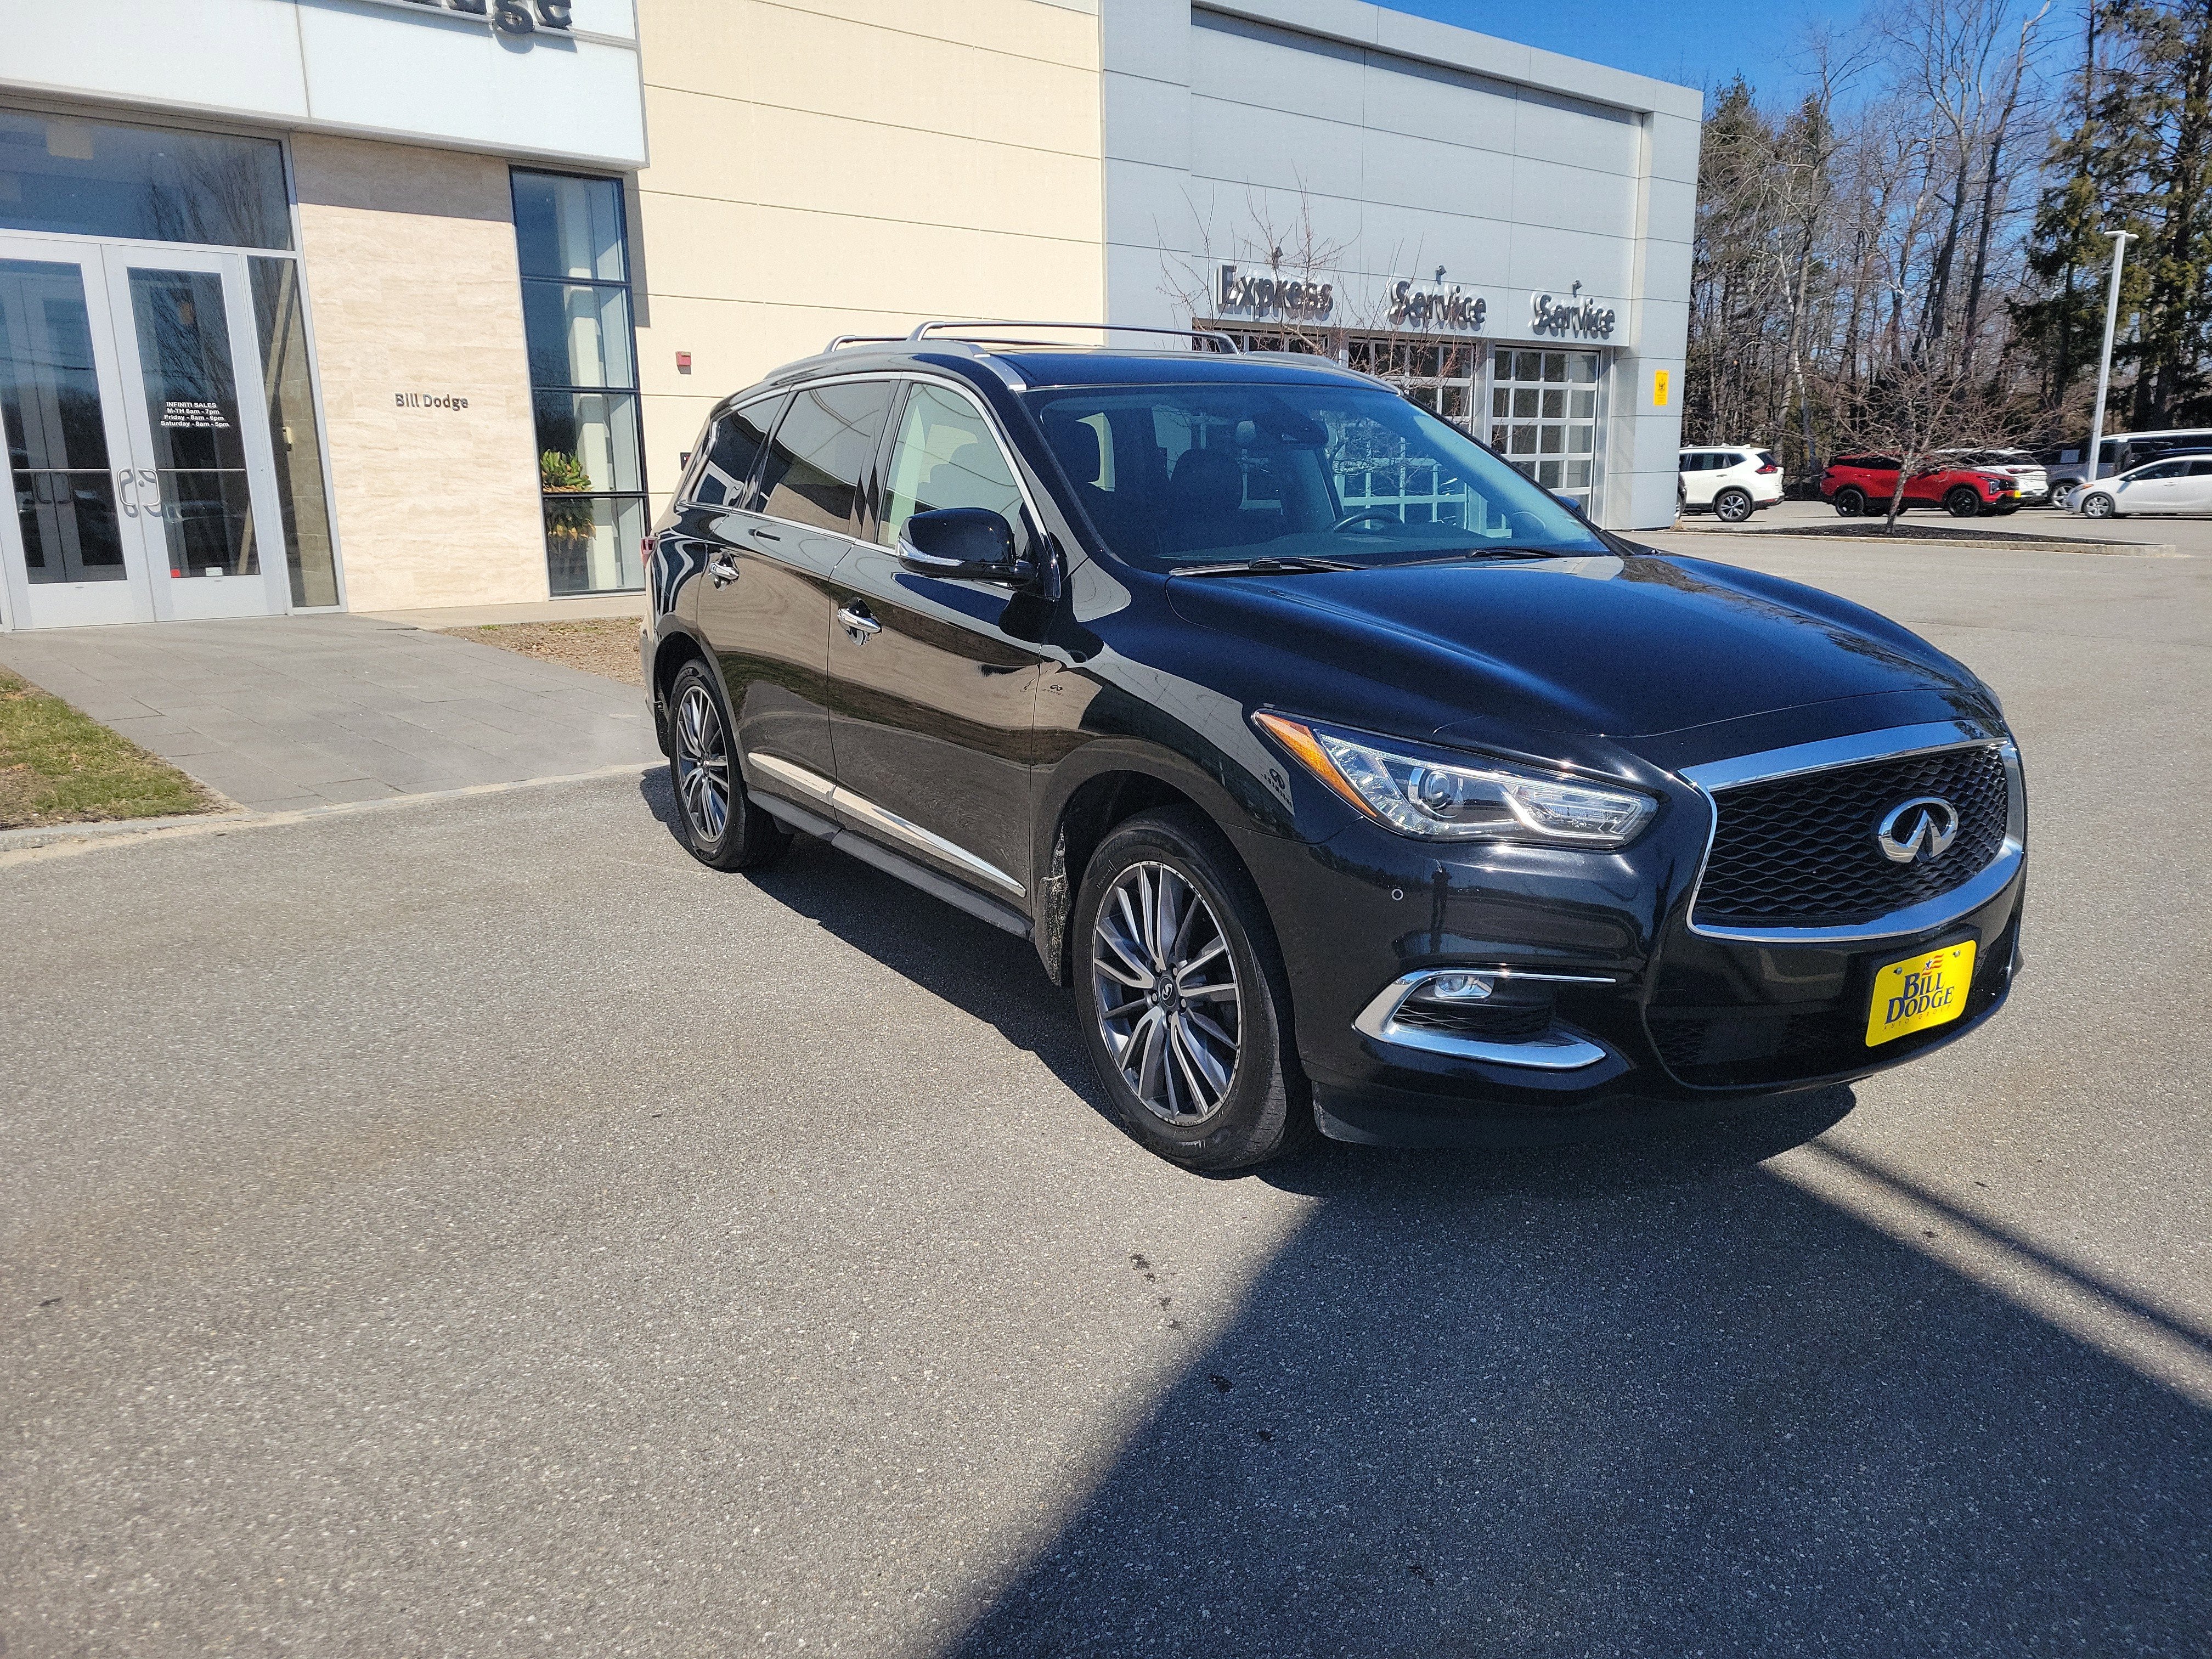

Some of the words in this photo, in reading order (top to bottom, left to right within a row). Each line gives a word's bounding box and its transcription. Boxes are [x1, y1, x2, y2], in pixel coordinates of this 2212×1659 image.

[1218, 264, 1334, 319] Express
[1392, 280, 1486, 326] Service
[1534, 294, 1615, 333] Service
[395, 392, 420, 407] Bill
[422, 393, 469, 411] Dodge
[1883, 1018, 1909, 1031] AUTO
[1918, 1004, 1950, 1019] GROUP
